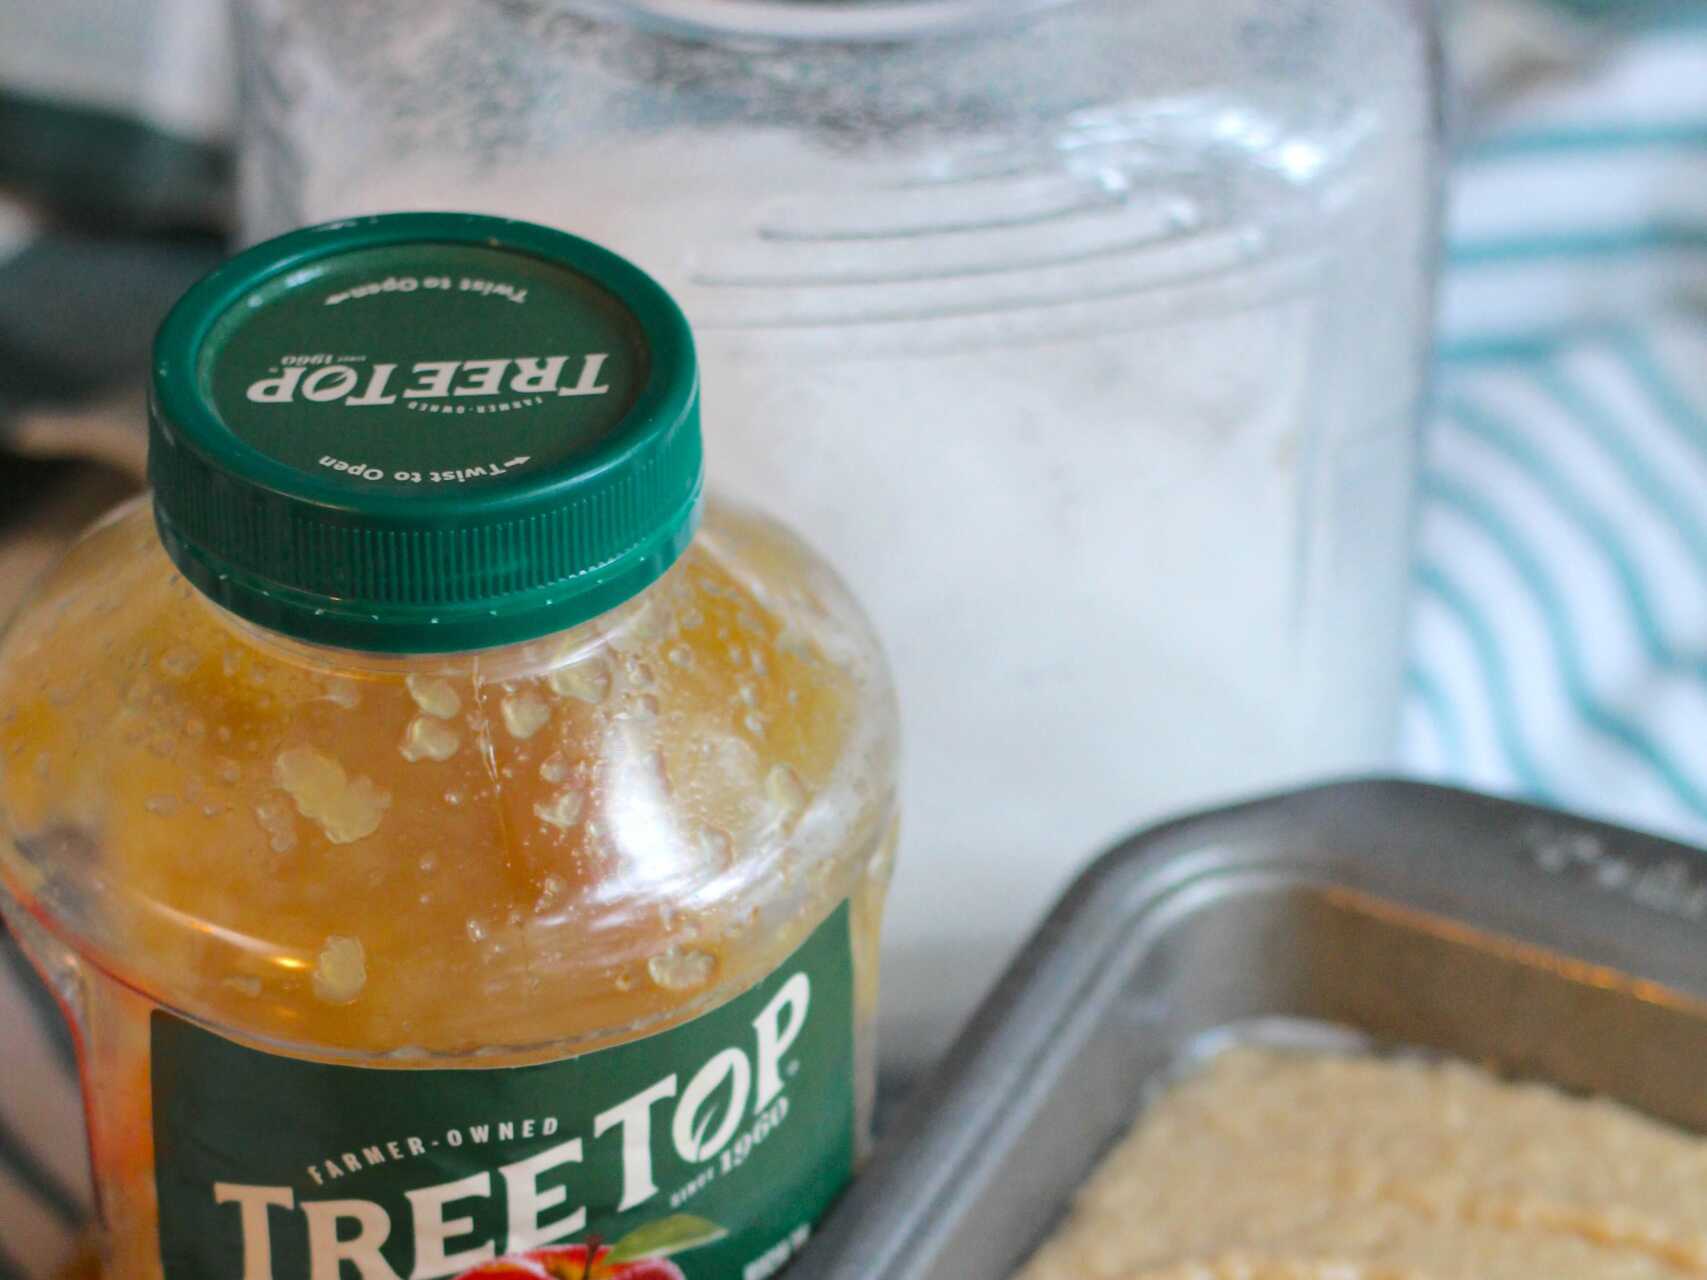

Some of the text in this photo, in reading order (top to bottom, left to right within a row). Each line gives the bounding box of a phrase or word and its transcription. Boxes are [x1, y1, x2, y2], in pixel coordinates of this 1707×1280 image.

[350, 276, 528, 303] Twist to Open
[246, 353, 609, 406] TREE TOP
[281, 353, 334, 366] 1960
[408, 397, 543, 414] FARMER-OWNED
[318, 455, 506, 483] Twist to Open
[593, 971, 812, 1214] TOP
[307, 1116, 560, 1186] FARMER-OWNED
[720, 1096, 789, 1175] 1960
